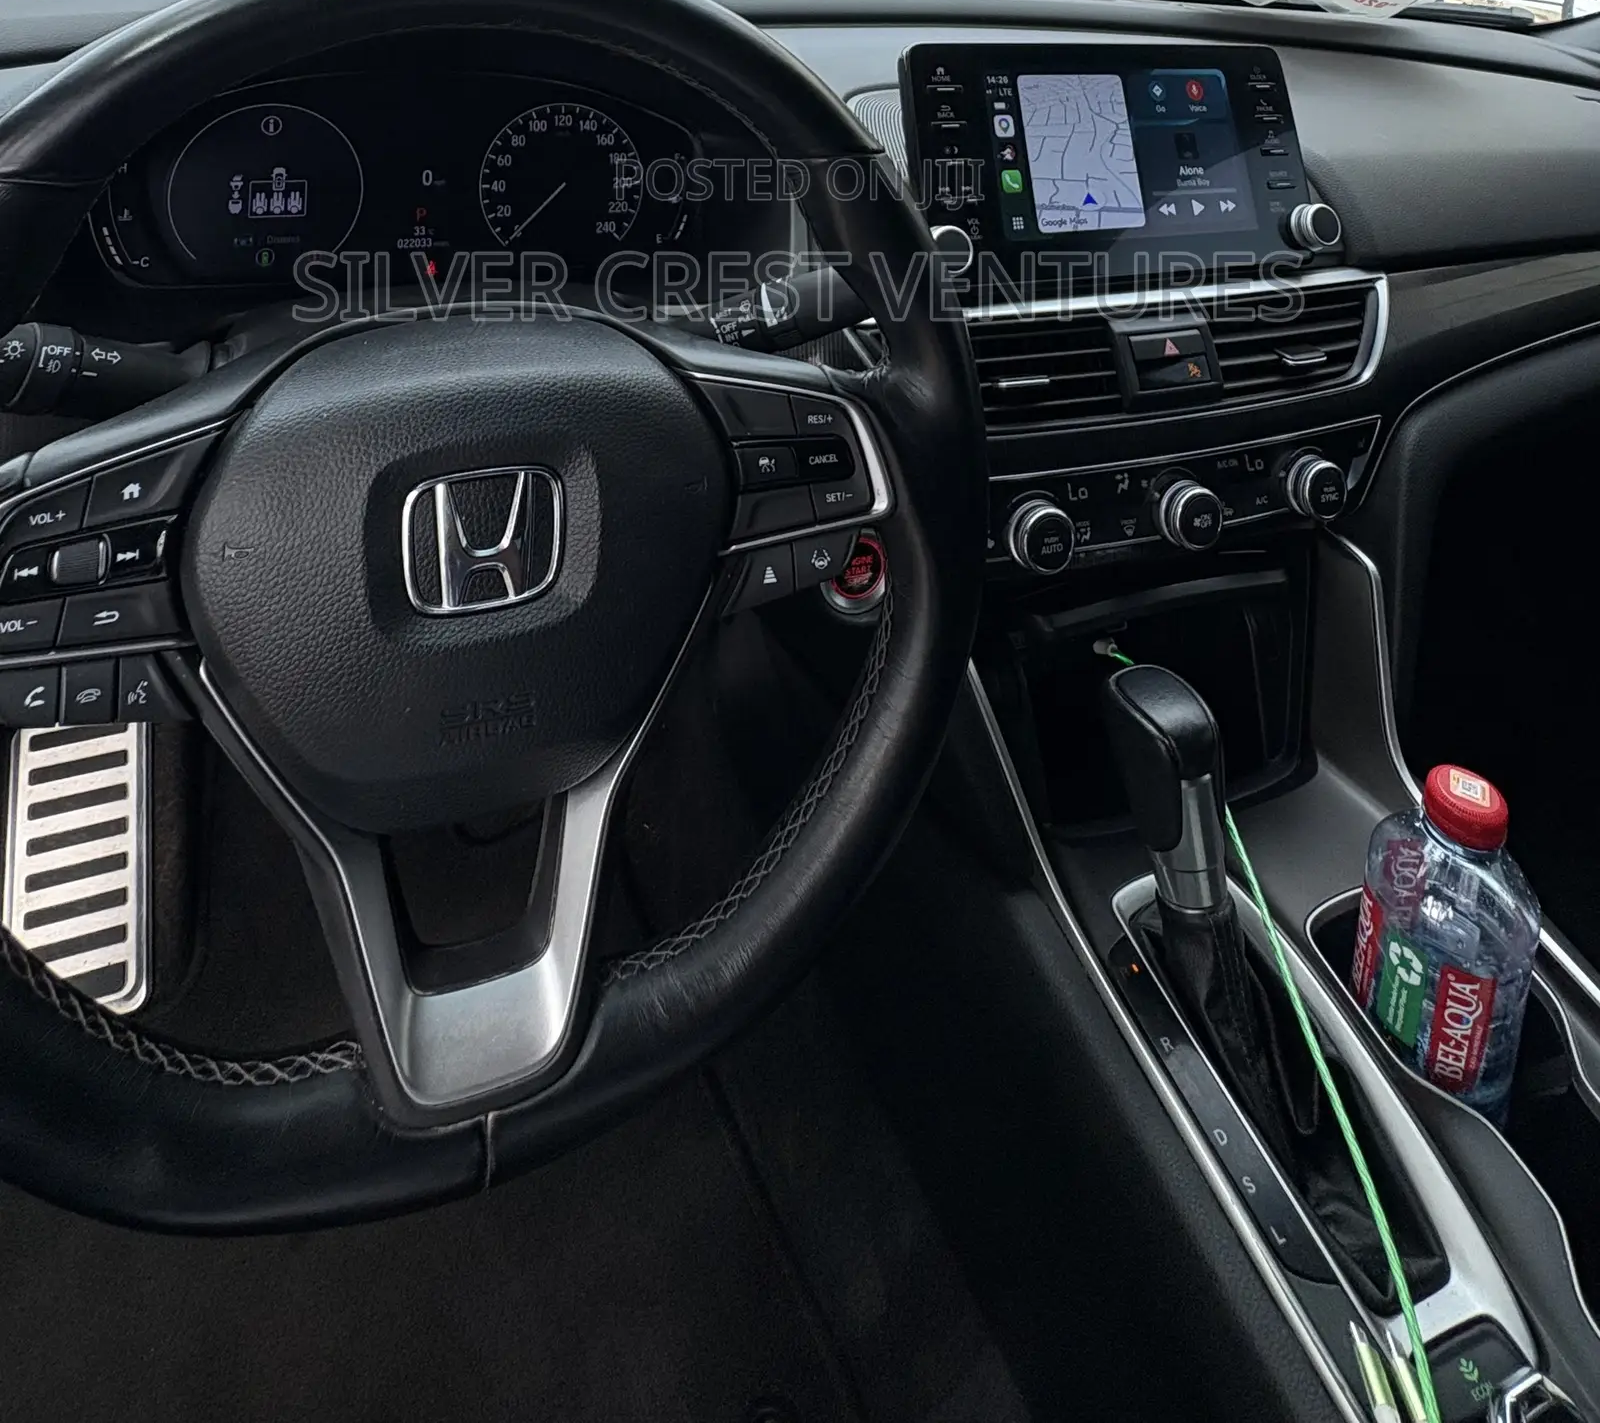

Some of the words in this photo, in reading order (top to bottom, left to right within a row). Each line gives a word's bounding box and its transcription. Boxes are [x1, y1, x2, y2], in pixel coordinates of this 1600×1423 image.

[999, 88, 1013, 97] LTE
[1188, 104, 1208, 113] Voice
[529, 120, 547, 132] 100
[554, 115, 573, 127] 120
[579, 120, 598, 132] 140
[511, 135, 526, 147] 80
[596, 134, 615, 146] 160
[497, 154, 512, 167] 60
[609, 152, 627, 164] 180
[1179, 166, 1204, 176] Alone
[422, 169, 433, 186] 0
[613, 177, 632, 189] 200
[491, 180, 506, 192] 40
[496, 205, 511, 217] 20
[608, 201, 628, 213] 220
[416, 207, 427, 222] P
[596, 221, 616, 233] 240
[1041, 218, 1067, 229] Google
[1069, 217, 1088, 226] Maps
[414, 226, 426, 236] 33
[397, 238, 432, 249] 022033
[656, 234, 662, 244] E
[140, 256, 150, 268] C
[721, 321, 737, 334] OFF
[725, 331, 740, 343] INT
[47, 345, 71, 356] OFF
[808, 414, 834, 425] RES/+
[808, 453, 838, 466] CANCEL
[1256, 495, 1269, 506] A/C
[1320, 493, 1340, 503] SYNC
[1041, 543, 1063, 555] AUTO
[1160, 1036, 1175, 1054] R
[1213, 1128, 1228, 1146] D
[1242, 1175, 1256, 1195] S
[1269, 1225, 1287, 1245] L
